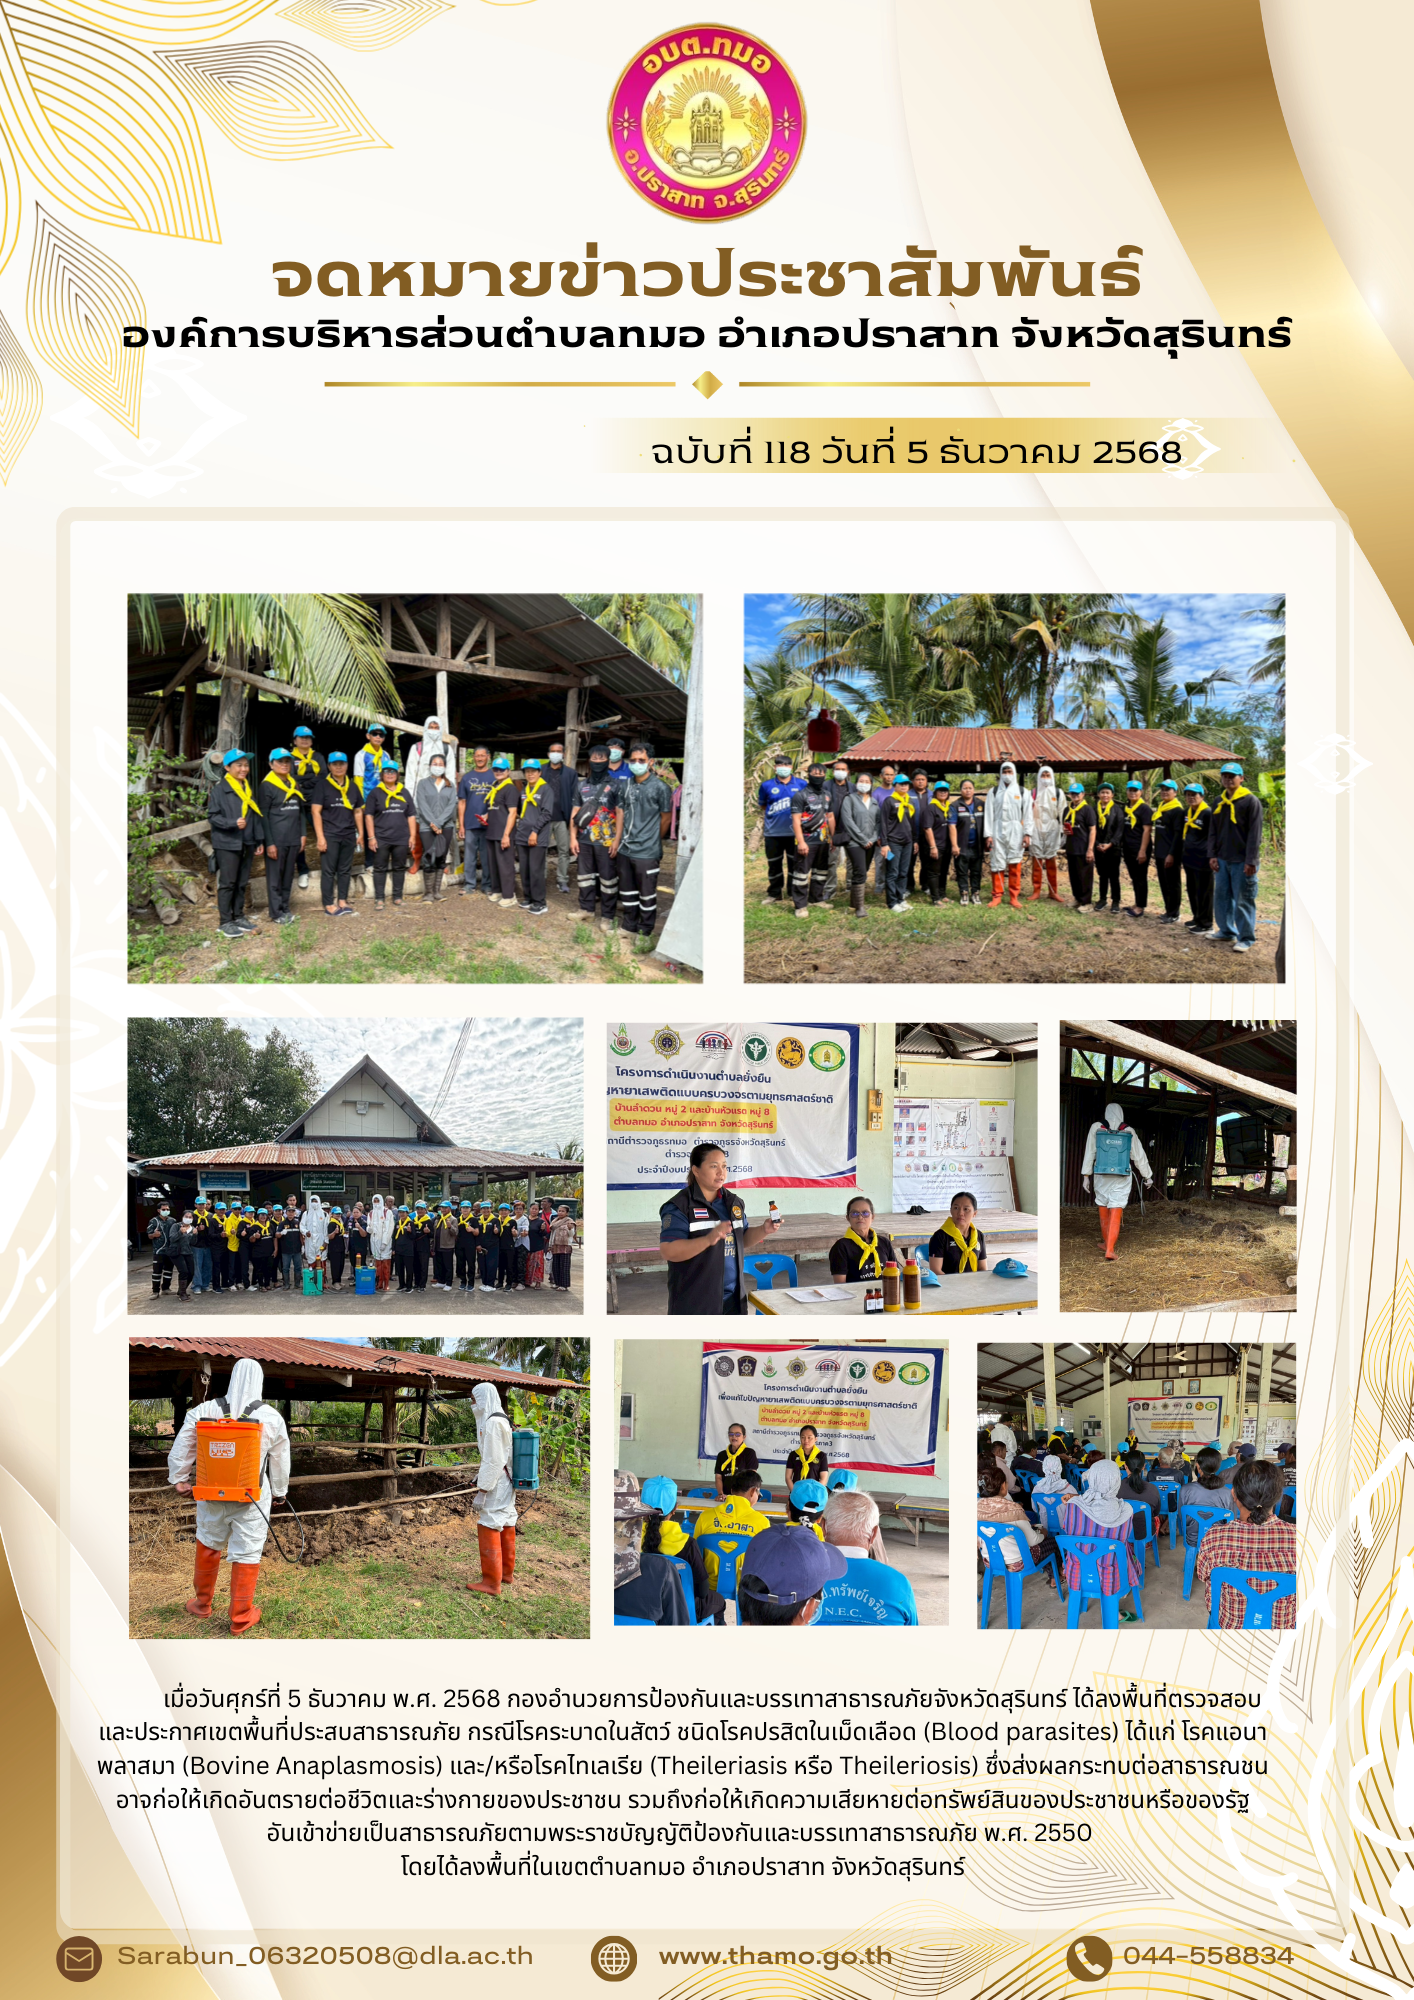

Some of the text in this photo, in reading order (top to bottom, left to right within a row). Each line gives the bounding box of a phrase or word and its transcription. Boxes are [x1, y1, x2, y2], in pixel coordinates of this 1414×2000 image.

[615, 1065, 771, 1083] โครงการดำเนินงานตำบลยั่งยืน
[614, 1102, 662, 1113] บ้านลำดวน
[665, 1105, 678, 1116] หมู่
[680, 1106, 687, 1114] 2
[750, 1107, 761, 1118] หมู่
[763, 1108, 770, 1116] 8
[613, 1116, 774, 1131] ตำบลทมอ อำเภอปราสาท จังหวัดสุรินทร์
